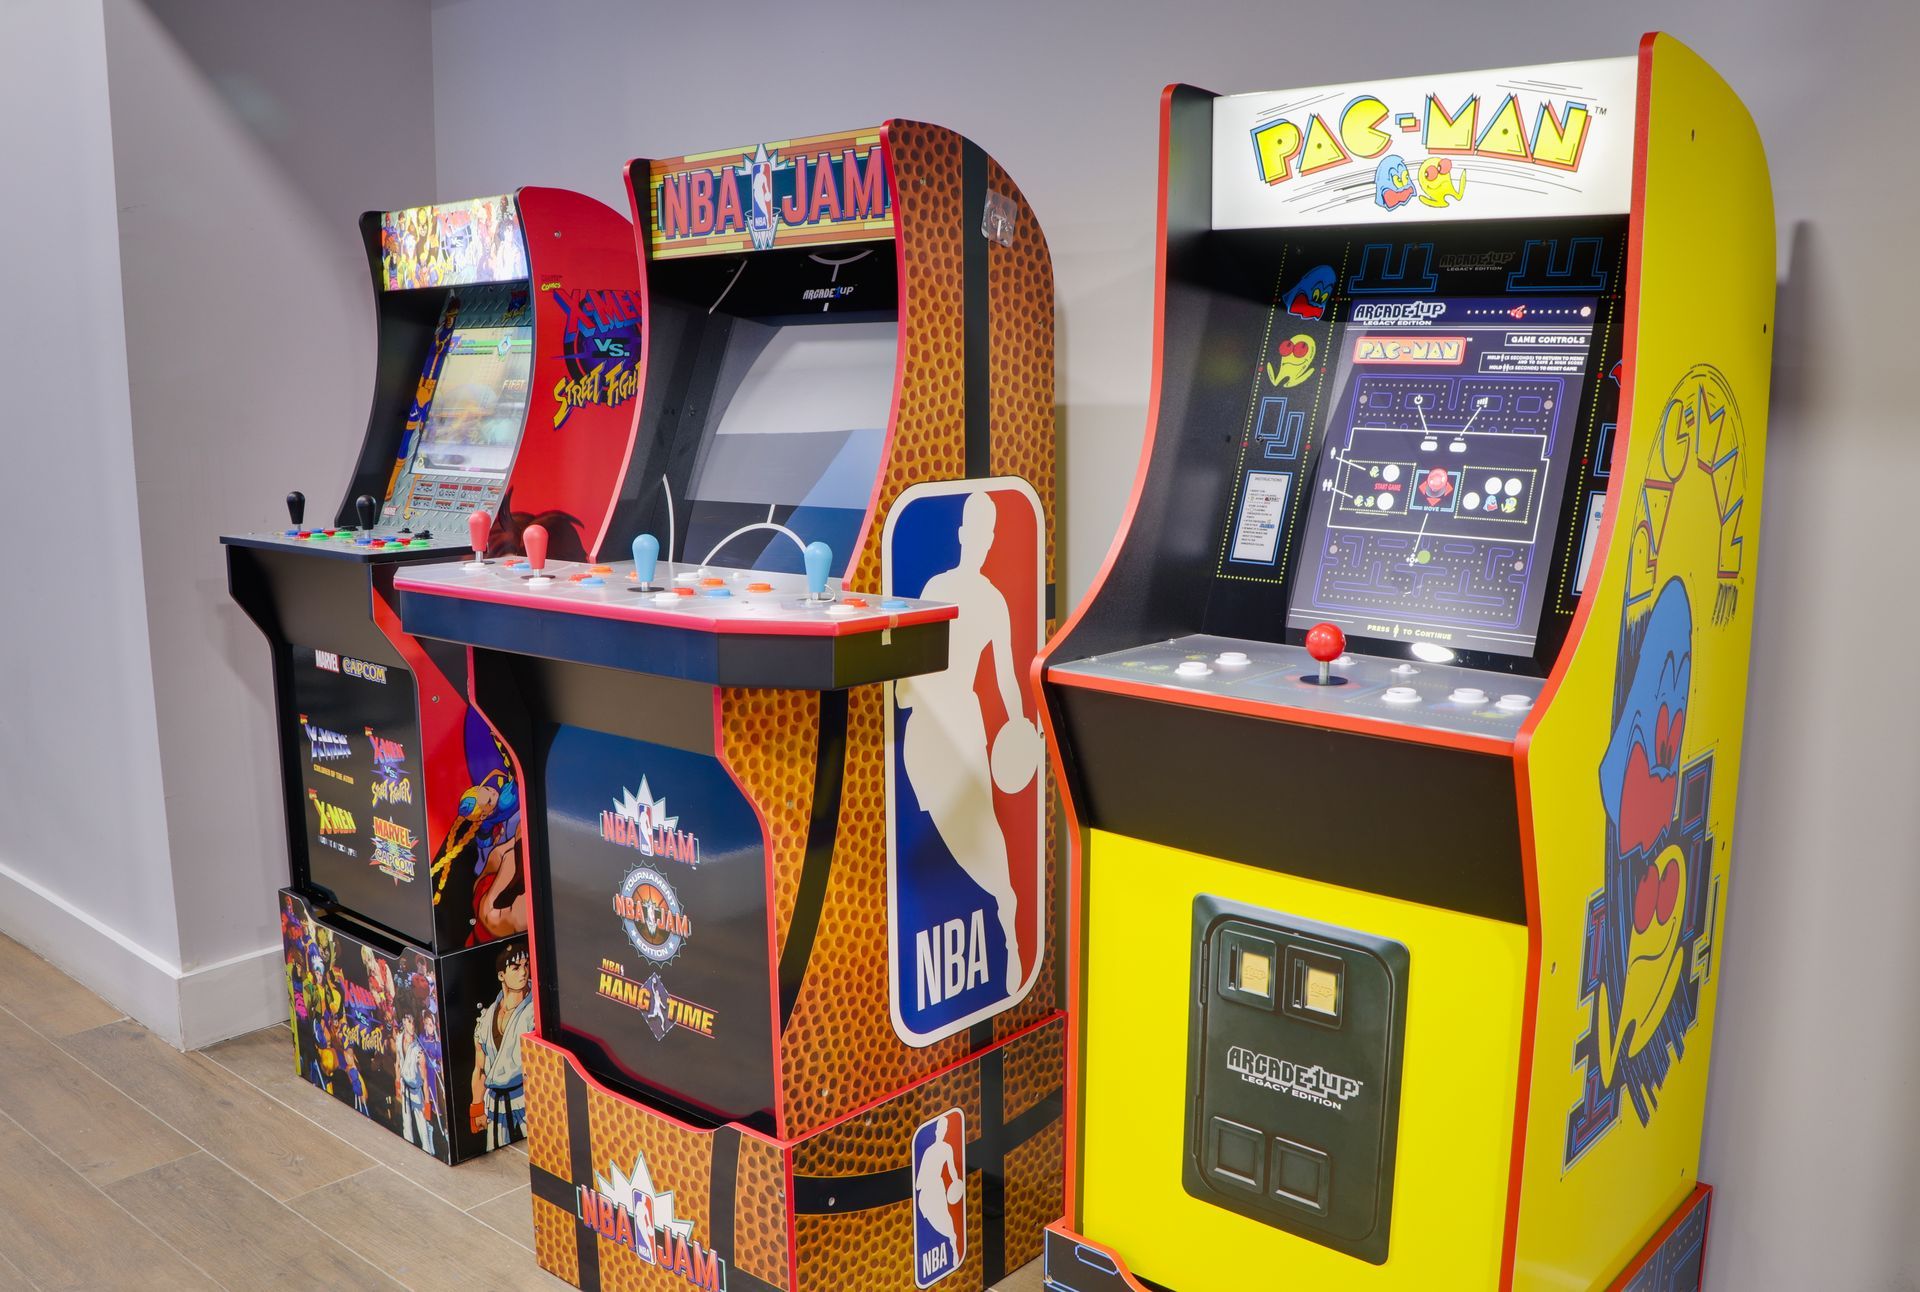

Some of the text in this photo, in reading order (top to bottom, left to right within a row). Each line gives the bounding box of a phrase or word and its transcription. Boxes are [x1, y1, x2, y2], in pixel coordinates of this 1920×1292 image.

[1250, 93, 1592, 186] PAC-MAN
[662, 145, 886, 240] NBA JAM
[1359, 341, 1459, 360] PAC-MAN
[1511, 336, 1586, 344] GAME CONTROLS
[1367, 624, 1390, 633] PRESS
[315, 649, 387, 684] MARVEL CAPCOM
[374, 817, 412, 849] MARVEL
[603, 810, 696, 865] NBA JAM
[375, 849, 415, 876] CAPCOM
[625, 869, 676, 907] TOURNAMENT
[615, 893, 689, 938] NBA JAM
[601, 957, 621, 973] NBA
[636, 938, 669, 956] EDITION
[916, 908, 989, 1012] NBA
[599, 973, 714, 1034] HANG TIME
[1241, 1073, 1342, 1111] LEGACY EDITION
[581, 1184, 720, 1292] NBA JAM
[922, 1241, 948, 1279] NBA
